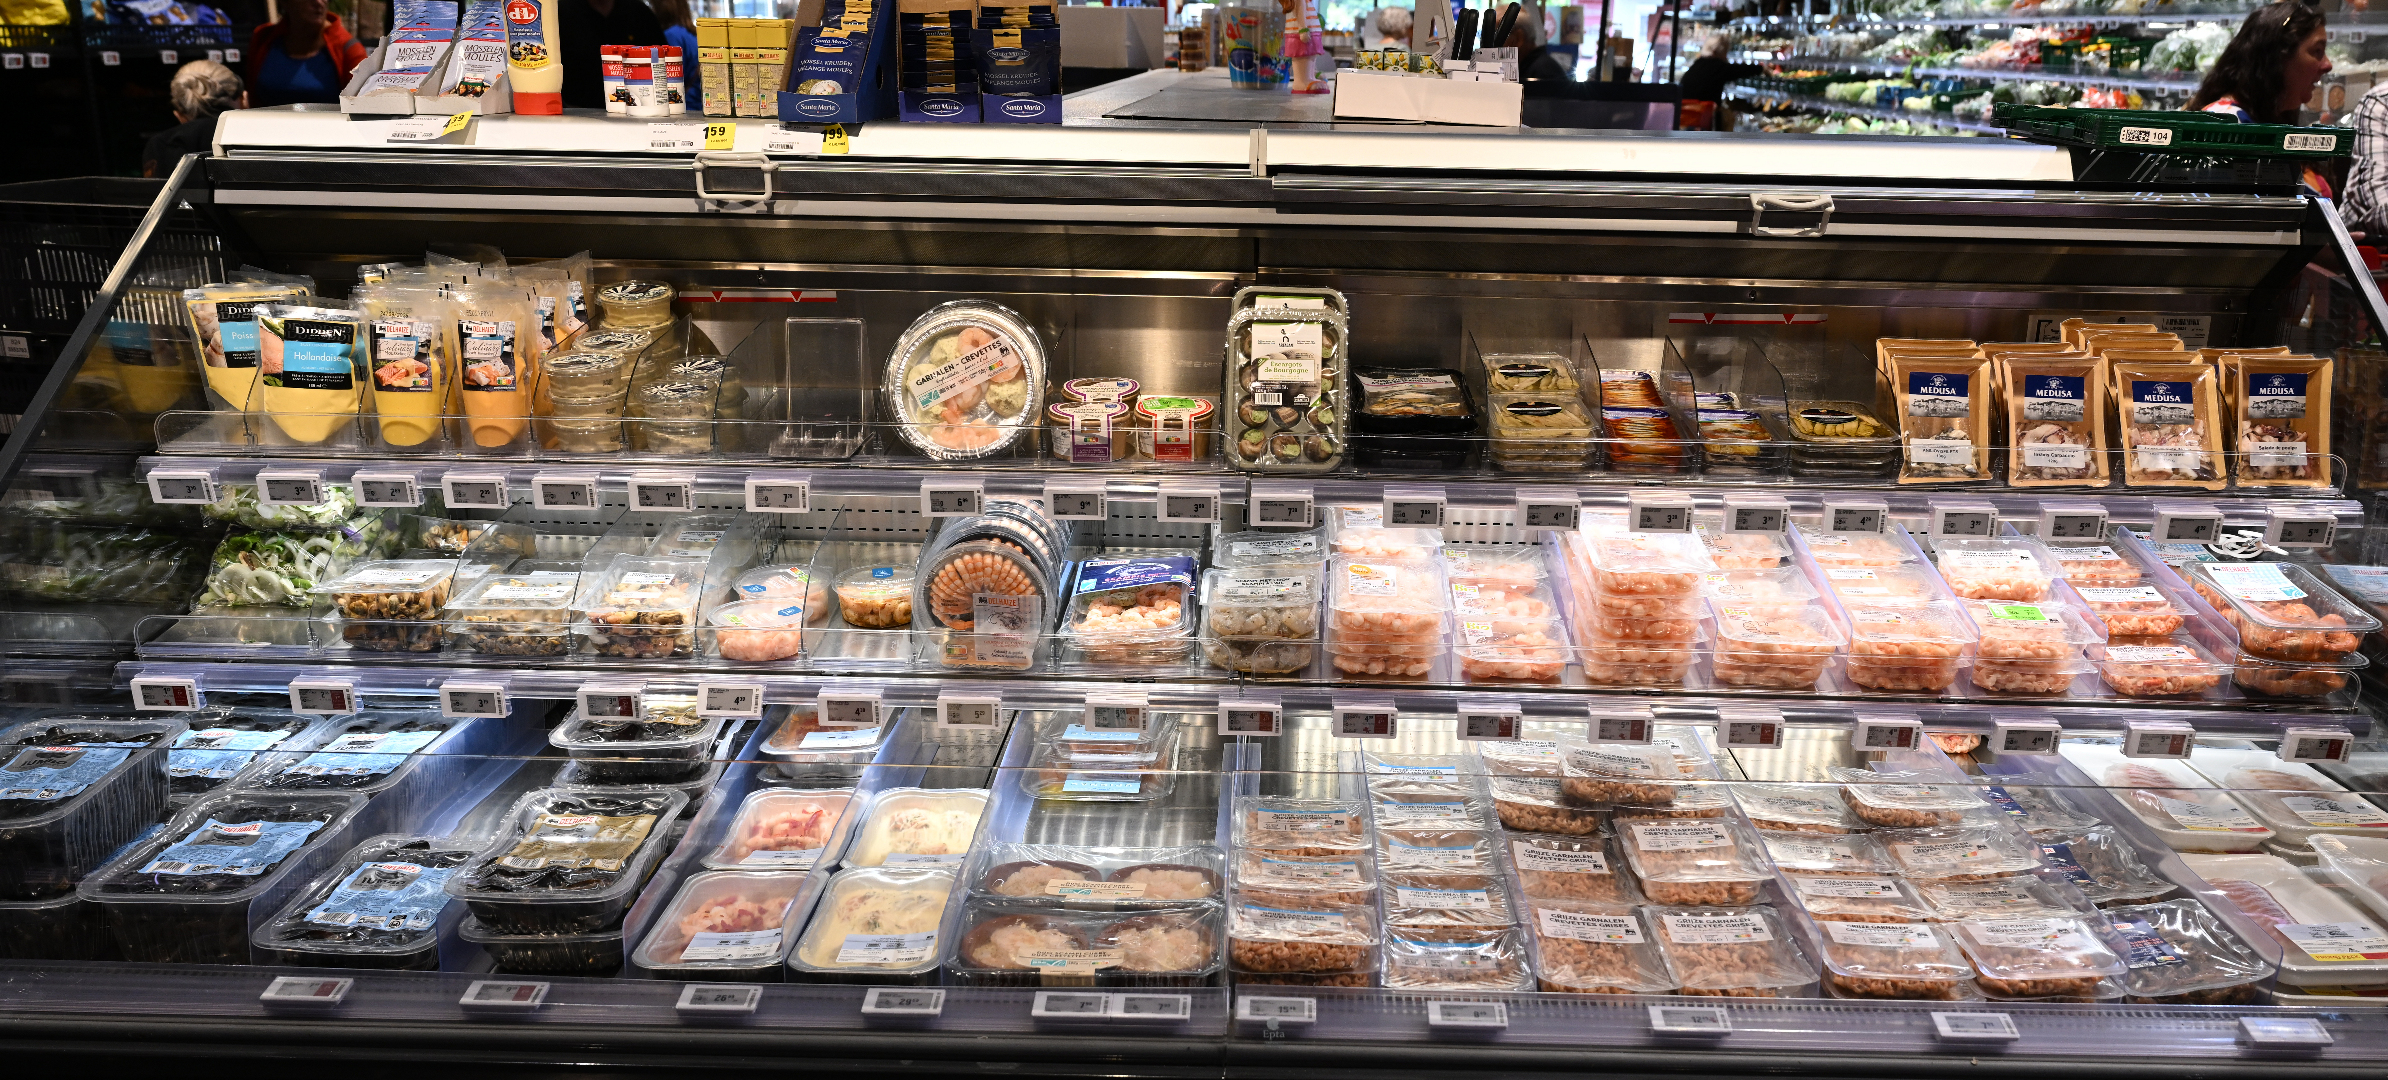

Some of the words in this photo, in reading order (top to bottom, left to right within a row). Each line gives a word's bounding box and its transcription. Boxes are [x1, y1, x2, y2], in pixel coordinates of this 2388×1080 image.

[815, 37, 832, 45] Santa
[833, 38, 849, 46] Maria
[398, 45, 437, 56] MOSSELEN
[465, 44, 505, 54] MOSSELEN
[464, 52, 502, 63] MOULES
[800, 103, 818, 111] Santa
[818, 103, 836, 111] Maria
[923, 102, 940, 110] Santa
[942, 102, 959, 110] Maria
[1006, 103, 1022, 111] Santa
[1023, 103, 1041, 111] Maria
[702, 126, 726, 140] 159
[822, 127, 843, 142] 199
[2152, 131, 2168, 141] 104
[386, 325, 410, 334] DELHAIZE
[472, 325, 496, 334] DELHAIZE
[293, 351, 342, 362] Hollandaise
[960, 340, 1002, 365] CREVETTES
[1270, 361, 1303, 369] Escargots
[1920, 386, 1956, 396] MEDUSA
[2035, 389, 2072, 398] MEDUSA
[2259, 387, 2294, 395] MEDUSA
[2144, 394, 2181, 402] MEDUSA
[1454, 584, 1477, 593] Bio
[988, 597, 1017, 607] DELHAIZE
[1466, 621, 1489, 631] Bio
[558, 815, 597, 825] DELHAIZE
[223, 823, 260, 834] DELHAIZE
[1523, 853, 1568, 862] CREVETTES
[1524, 849, 1551, 857] GRIJZE
[382, 864, 420, 873] DELHAIZE
[1550, 917, 1598, 926] CREVETTES
[1263, 1029, 1285, 1039] Epta
